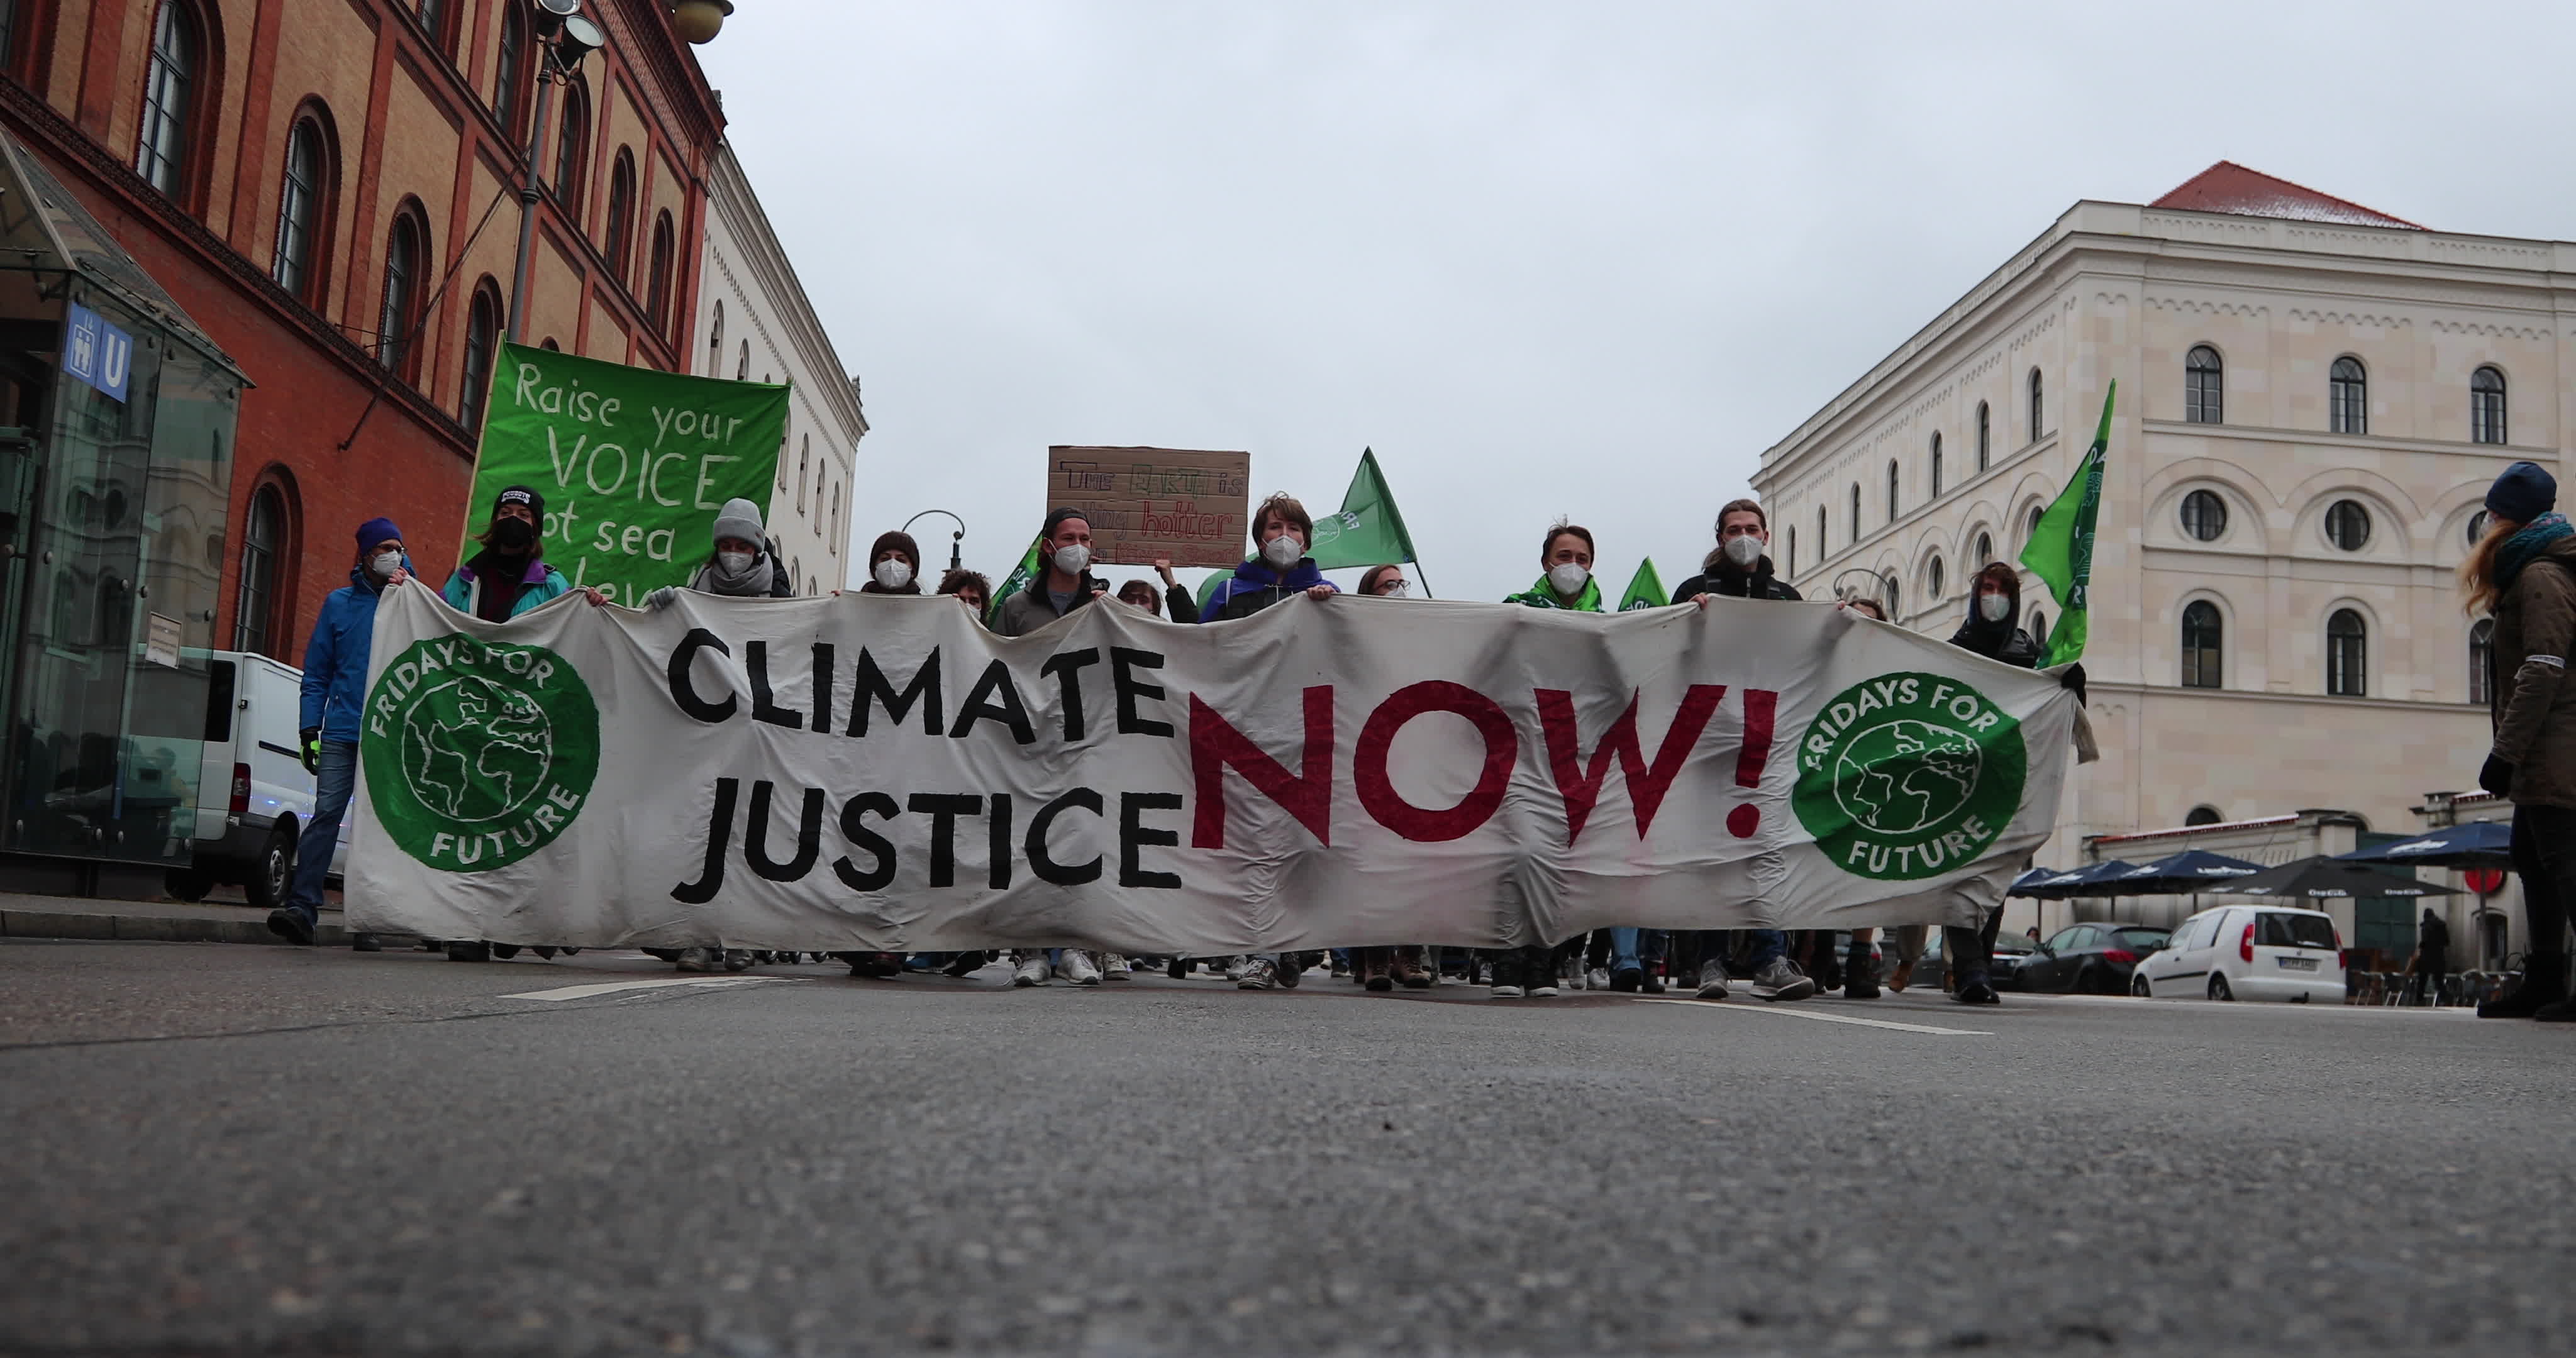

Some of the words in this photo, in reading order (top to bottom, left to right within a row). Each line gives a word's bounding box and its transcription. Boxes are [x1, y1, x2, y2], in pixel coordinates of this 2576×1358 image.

[106, 333, 125, 387] U
[515, 363, 621, 427] Raise
[652, 406, 743, 448] your
[548, 426, 743, 510] VOICE
[1060, 461, 1116, 490] THE
[1130, 464, 1209, 498] EARTH
[1218, 472, 1243, 497] is
[542, 500, 579, 543] ot
[593, 520, 675, 563] sea
[1141, 501, 1233, 539] hotter
[370, 639, 475, 739] FRIDAYS
[485, 646, 554, 689] FOR
[667, 628, 1175, 745] CLIMATE
[1805, 677, 1919, 772] FRIDAYS
[1929, 684, 1999, 733] FOR
[1190, 680, 1779, 849] NOW!
[430, 783, 580, 864] FUTURE
[670, 778, 1183, 904] JUSTICE
[1848, 814, 1993, 873] FUTURE
